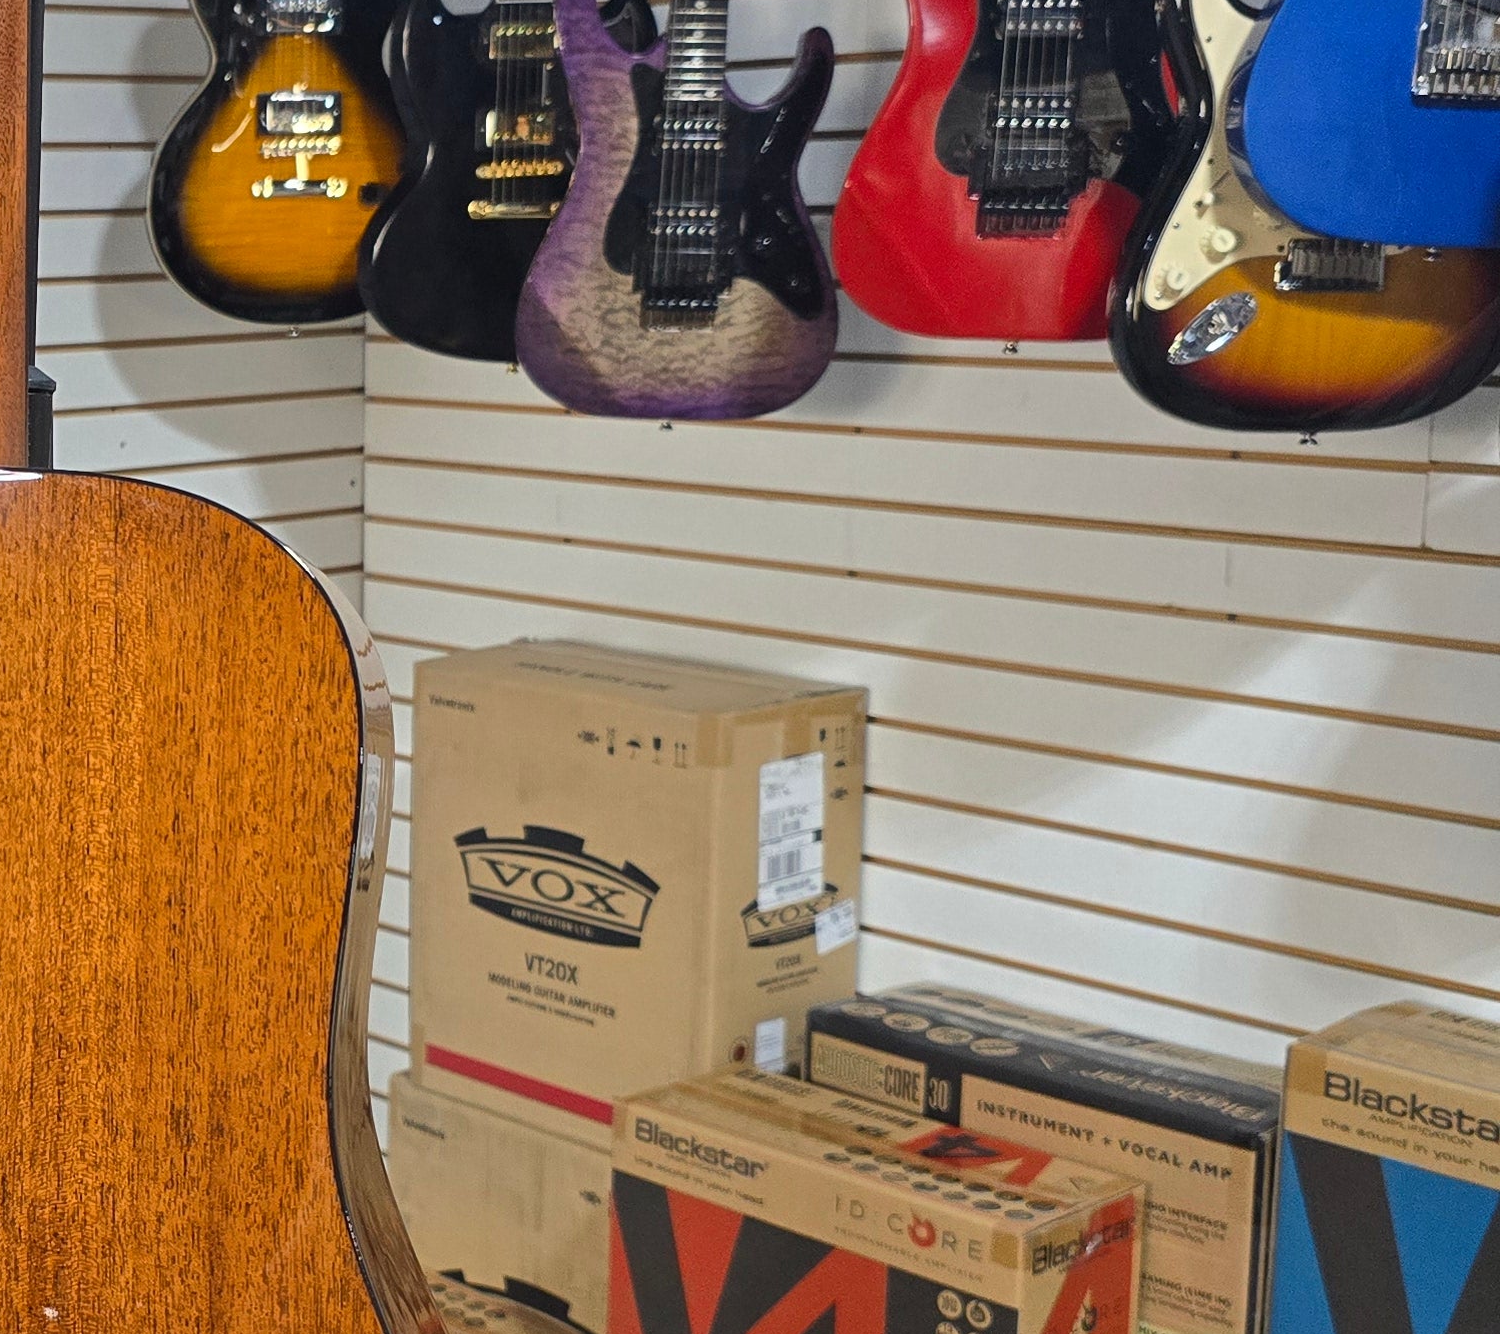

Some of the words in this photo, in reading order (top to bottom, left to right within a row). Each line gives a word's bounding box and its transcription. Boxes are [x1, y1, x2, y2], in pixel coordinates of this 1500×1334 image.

[480, 857, 625, 919] VOX
[525, 953, 579, 985] VT20X
[488, 972, 531, 994] MODELING
[534, 984, 565, 1004] GUITAR
[568, 994, 615, 1018] AMPLIFIER
[928, 1077, 949, 1112] 30
[634, 1117, 766, 1179] Blackstar
[977, 1099, 1094, 1143] INSTRUMENT
[1119, 1138, 1182, 1167] VOCAL
[1189, 1158, 1233, 1181] AMP
[1322, 1118, 1349, 1133] the
[1355, 1128, 1408, 1150] sound
[1414, 1139, 1429, 1155] in
[1433, 1149, 1474, 1167] your
[1369, 1114, 1473, 1148] AMPLIFICATION
[1032, 1218, 1130, 1276] Blackstar
